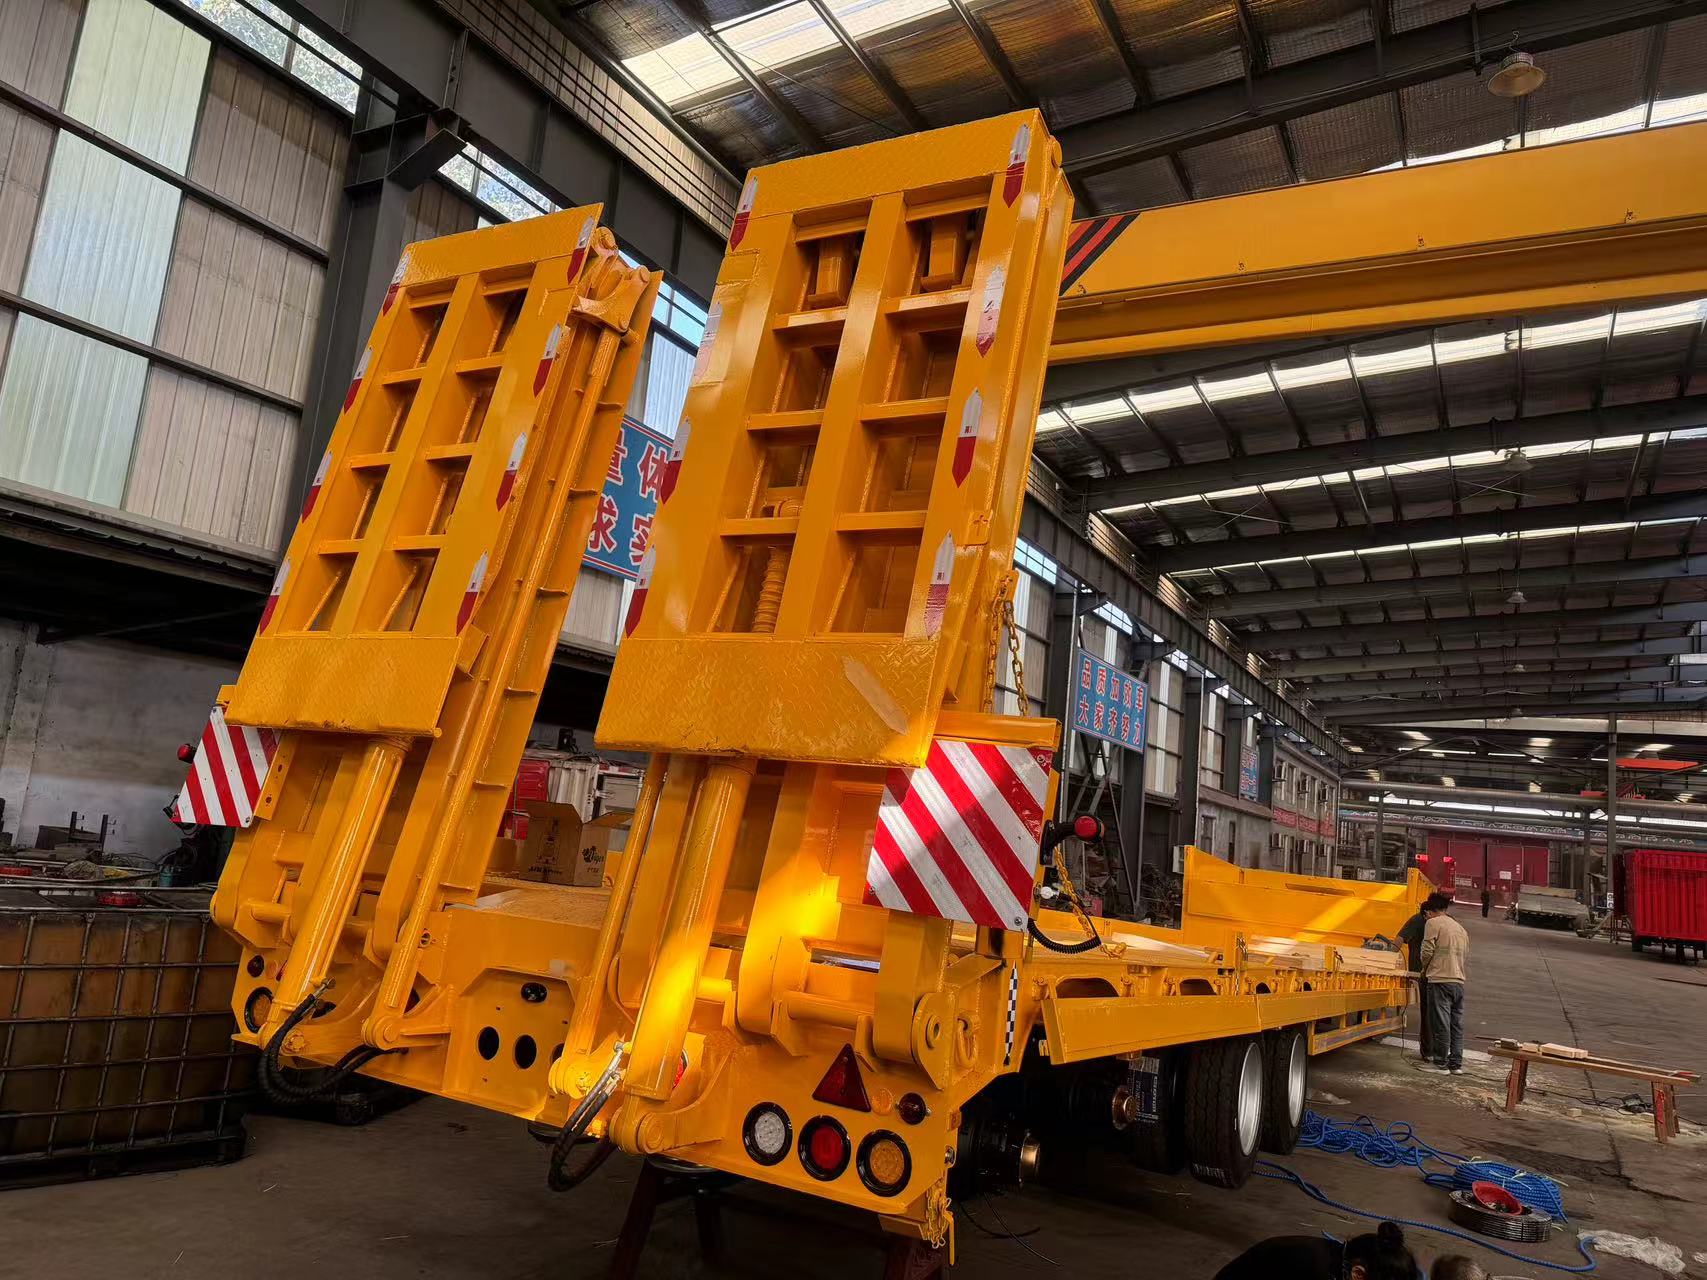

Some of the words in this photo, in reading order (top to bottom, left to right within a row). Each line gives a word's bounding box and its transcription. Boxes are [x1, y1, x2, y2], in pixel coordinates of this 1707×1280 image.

[1078, 694, 1141, 744] 大家齐努力
